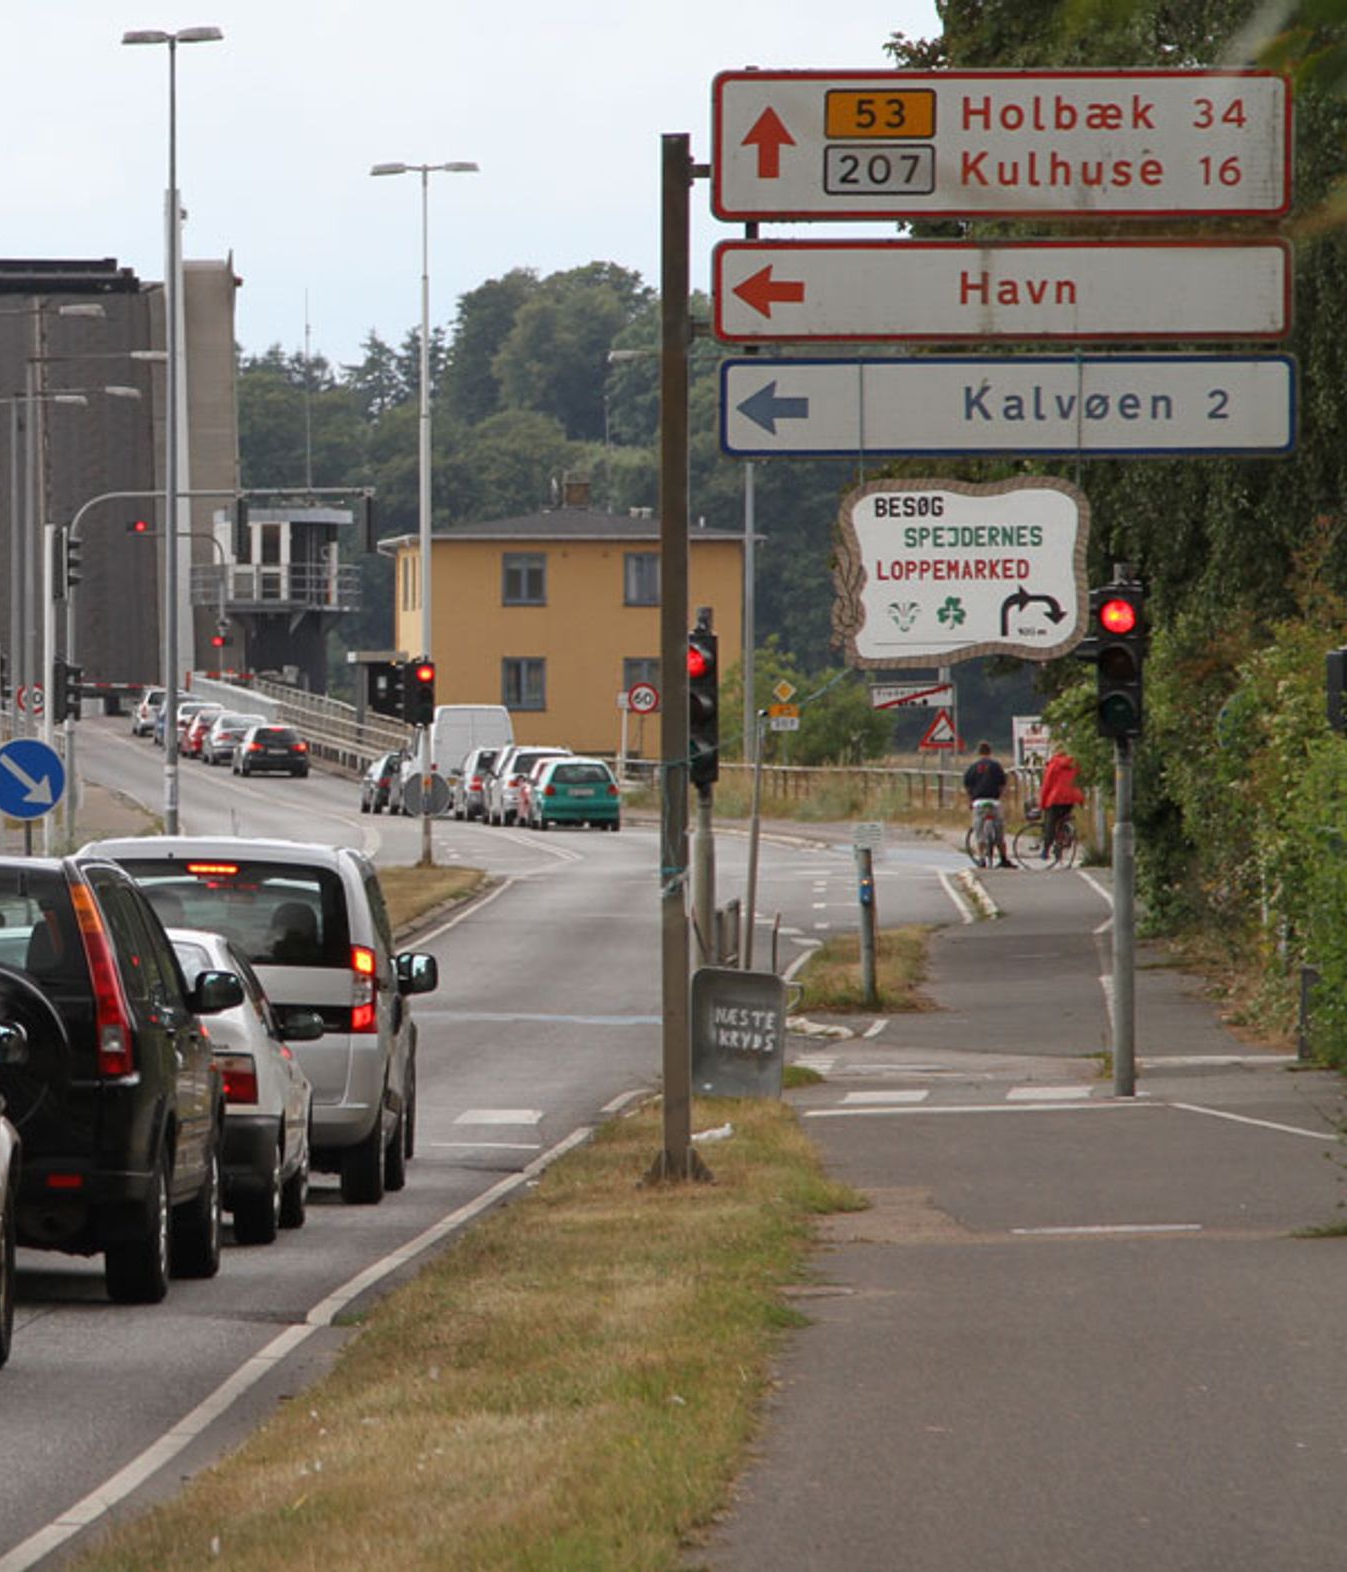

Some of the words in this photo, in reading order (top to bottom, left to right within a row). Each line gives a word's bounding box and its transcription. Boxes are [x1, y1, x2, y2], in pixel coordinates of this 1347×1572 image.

[855, 98, 906, 129] 53
[961, 94, 1156, 132] Holbæk
[1192, 98, 1247, 129] 34
[839, 154, 920, 185] 207
[961, 151, 1164, 188] Kulhuse
[1199, 155, 1242, 187] 16
[959, 271, 1077, 305] Havn
[963, 385, 1173, 421] Kalvøen
[1207, 389, 1230, 420] 2
[904, 525, 1043, 547] SPEJDERNES
[876, 559, 1030, 580] LOPPEMARKED
[633, 691, 653, 706] 60
